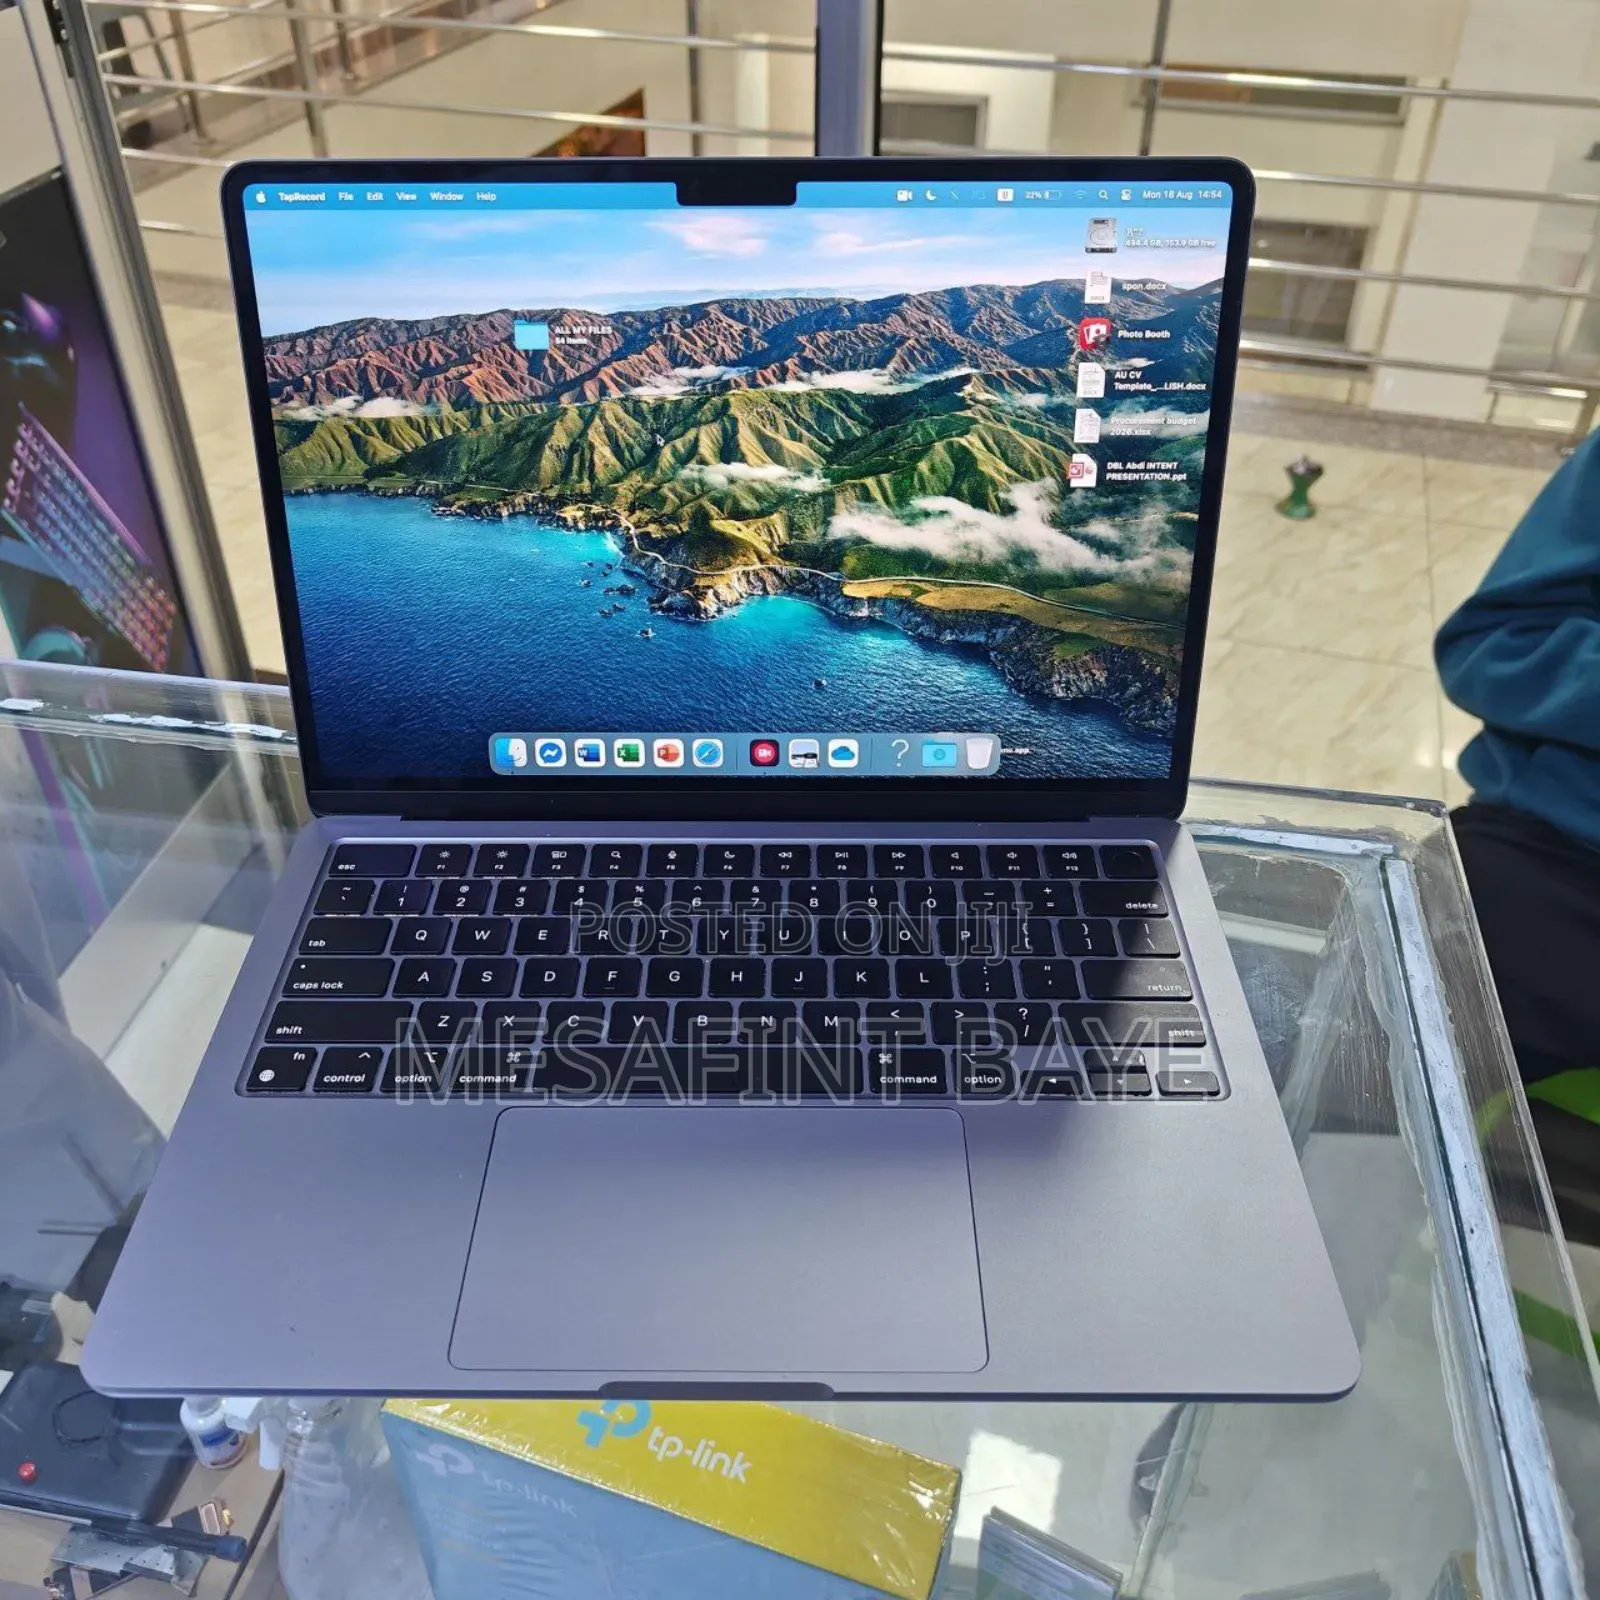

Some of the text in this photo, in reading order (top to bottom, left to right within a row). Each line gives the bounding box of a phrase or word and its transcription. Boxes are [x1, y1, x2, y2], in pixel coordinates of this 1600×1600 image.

[278, 191, 326, 202] TapRecord
[338, 191, 354, 201] File
[366, 191, 383, 201] Edit
[396, 191, 416, 201] View
[430, 191, 464, 201] Window
[476, 191, 496, 203] Help
[1142, 189, 1161, 199] Mon
[1175, 189, 1194, 201] Aug
[1198, 189, 1222, 199] 14:54
[555, 325, 571, 335] ALL
[588, 325, 613, 335] FILES
[1118, 329, 1171, 339] Photo Booth
[1114, 370, 1143, 380] AU CV
[1110, 416, 1197, 427] Procurement budget
[1106, 461, 1124, 470] DBL
[1146, 461, 1178, 470] INTENT
[1105, 472, 1188, 482] PRESENTATION.ppt
[398, 898, 405, 908] 1
[456, 898, 466, 908] 2
[515, 898, 525, 908] 3
[574, 898, 584, 908] 4
[633, 898, 643, 908] 5
[691, 898, 702, 908] 6
[751, 898, 760, 908] 7
[809, 898, 819, 908] 8
[868, 898, 878, 908] 9
[1125, 902, 1159, 910] delete
[415, 930, 428, 941] Q
[474, 930, 491, 941] W
[538, 930, 549, 941] E
[598, 930, 609, 941] R
[659, 930, 670, 941] T
[719, 930, 730, 941] Y
[778, 930, 790, 941] U
[899, 930, 911, 941] O
[960, 930, 971, 941] P
[308, 939, 326, 948] tab
[417, 971, 430, 983] A
[481, 971, 494, 983] S
[544, 971, 556, 983] D
[607, 971, 618, 983] F
[668, 971, 681, 983] G
[731, 971, 743, 983] H
[794, 971, 804, 983] J
[856, 971, 867, 983] K
[919, 971, 930, 983] L
[293, 980, 344, 990] caps lock
[1147, 983, 1183, 992] return
[437, 1015, 450, 1027] Z
[502, 1015, 515, 1027] X
[567, 1015, 580, 1027] C
[632, 1015, 645, 1027] V
[697, 1015, 708, 1027] B
[761, 1015, 774, 1027] N
[824, 1015, 839, 1027] M
[275, 1026, 303, 1035] shift
[1168, 1028, 1195, 1037] shift
[292, 1052, 306, 1061] fn
[323, 1074, 366, 1083] control
[394, 1074, 432, 1084] option
[459, 1074, 517, 1083] command
[879, 1075, 937, 1084] command
[964, 1075, 1002, 1085] option
[647, 1424, 753, 1483] tp-link
